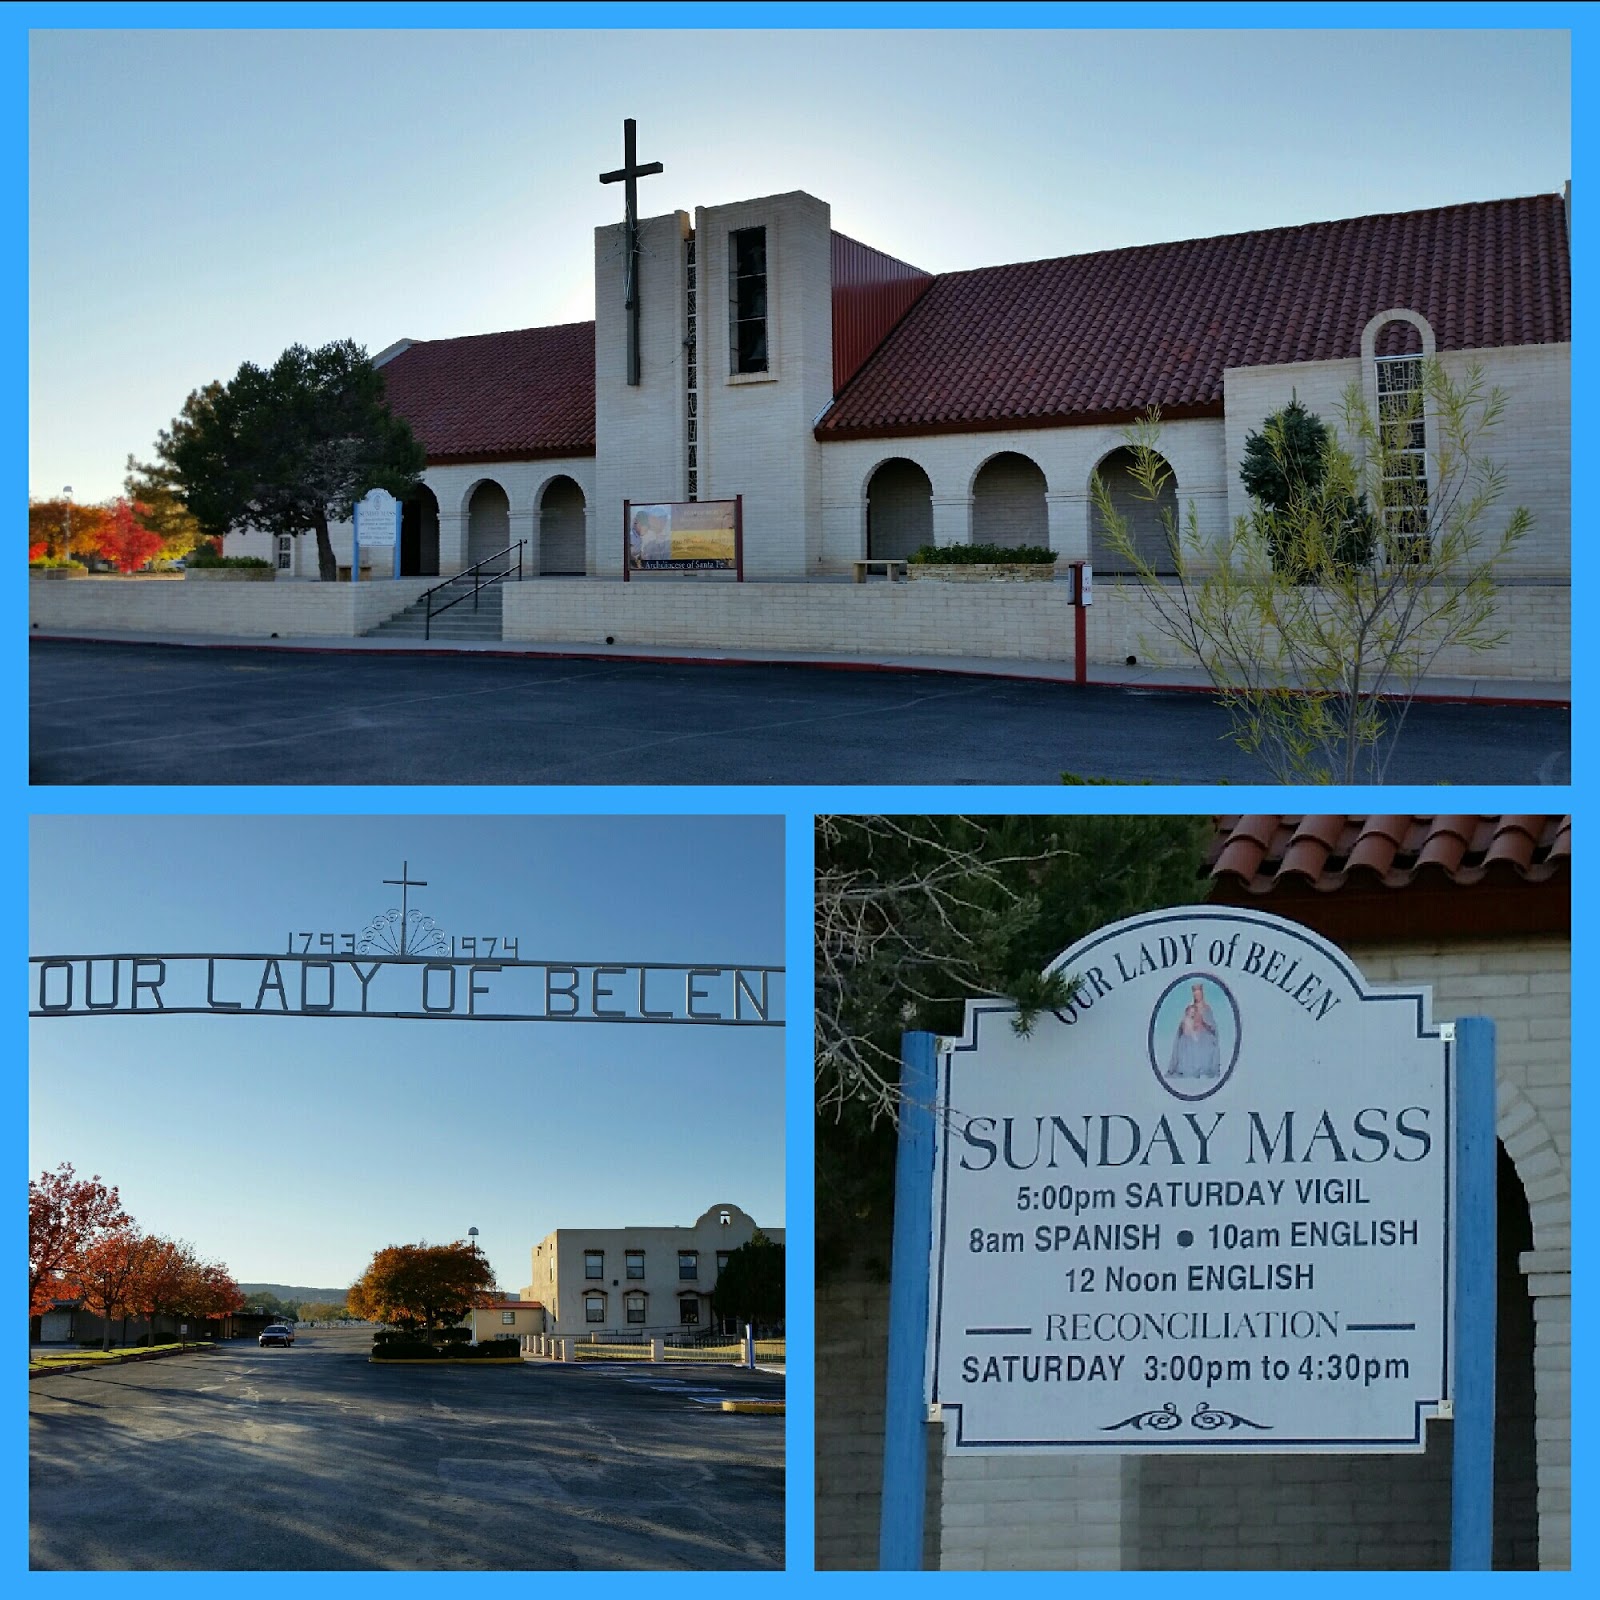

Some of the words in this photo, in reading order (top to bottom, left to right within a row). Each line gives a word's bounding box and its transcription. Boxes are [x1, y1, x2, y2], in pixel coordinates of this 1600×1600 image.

[645, 561, 685, 569] Archdiocese
[687, 560, 694, 569] of
[695, 560, 714, 568] Santa
[285, 932, 356, 956] 1793
[451, 935, 519, 960] 1974
[39, 959, 166, 1011] OUR
[207, 958, 382, 1012] LADY
[422, 963, 503, 1015] OF
[545, 966, 768, 1021] BELEN
[1113, 933, 1198, 983] LADY
[1208, 933, 1239, 968] of
[1241, 942, 1341, 1022] BELEN
[960, 1111, 1225, 1170] SUNDAY
[1247, 1107, 1431, 1164] MASS
[1017, 1185, 1116, 1215] 5:00pm
[1125, 1180, 1285, 1208] SATURDAY
[1295, 1178, 1370, 1204] VIGIL
[969, 1228, 1024, 1252] 8am
[1035, 1224, 1161, 1251] SPANISH
[1208, 1224, 1280, 1248] 10am
[1290, 1220, 1418, 1247] ENGLISH
[1065, 1267, 1095, 1292] 12
[1106, 1267, 1177, 1292] Noon
[1187, 1265, 1315, 1291] ENGLISH
[1045, 1310, 1340, 1342] RECONCILIATION
[962, 1355, 1125, 1383] SATURDAY
[1144, 1355, 1251, 1387] 3:00pm
[1262, 1355, 1289, 1381] to
[1298, 1353, 1409, 1385] 4:30pm
